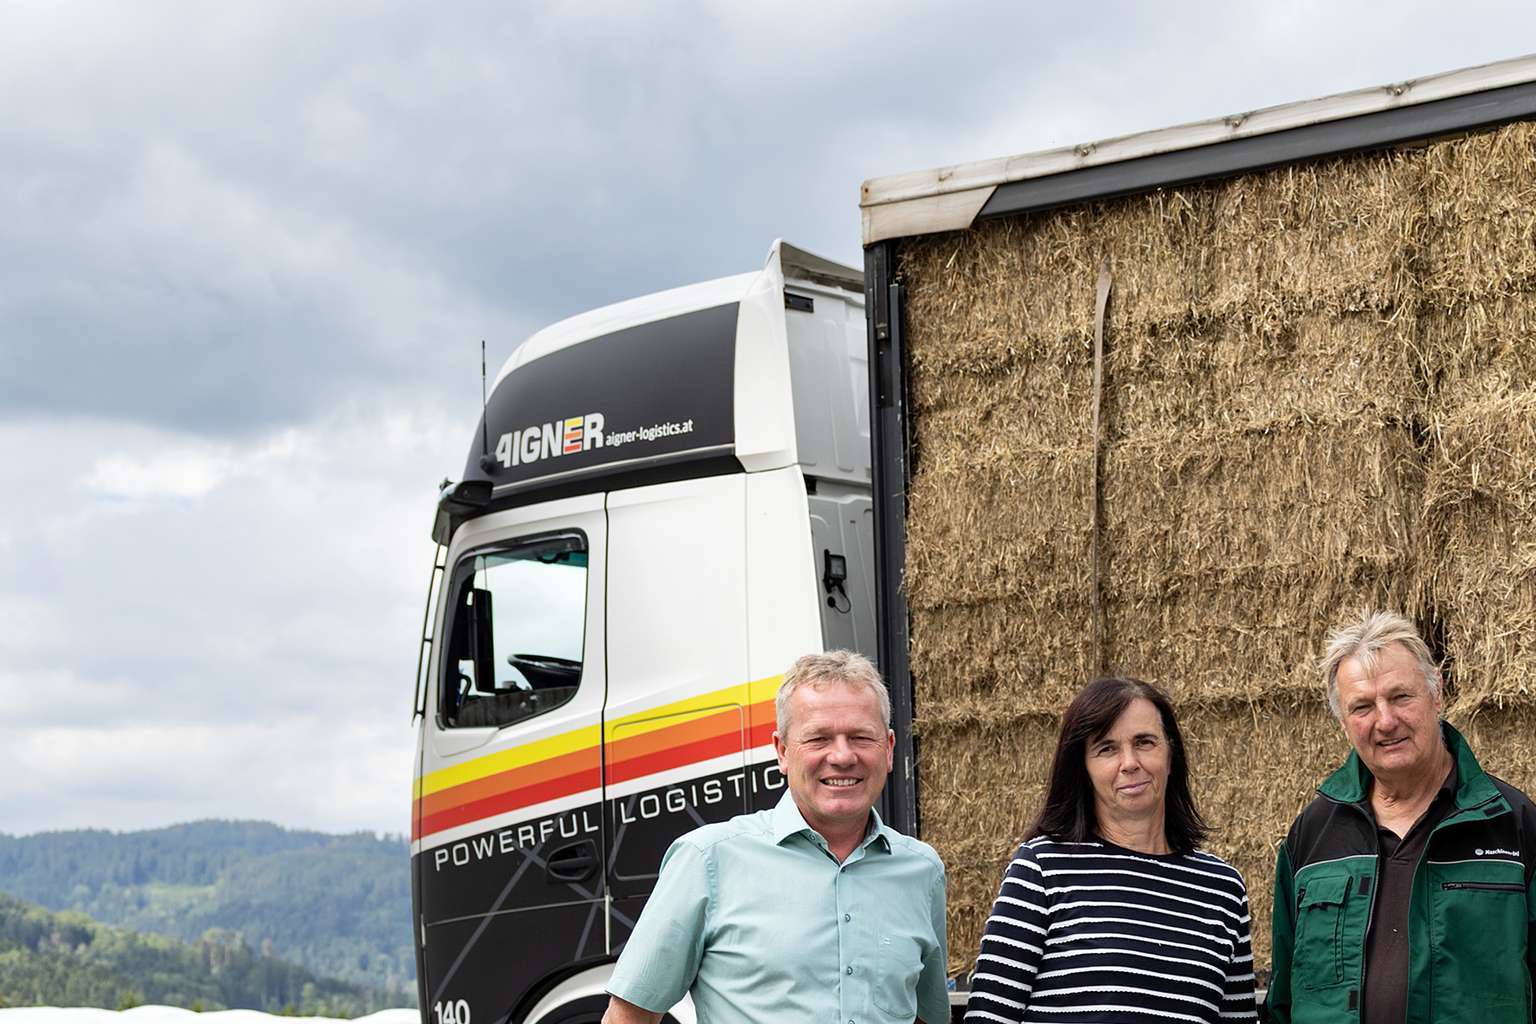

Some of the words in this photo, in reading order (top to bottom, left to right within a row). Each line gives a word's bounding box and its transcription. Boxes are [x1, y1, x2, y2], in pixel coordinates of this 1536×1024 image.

[495, 412, 605, 468] AIGNER
[605, 419, 694, 447] aigner-logistics.at
[435, 810, 599, 872] POWERFUL
[620, 765, 785, 824] LOGISTIC
